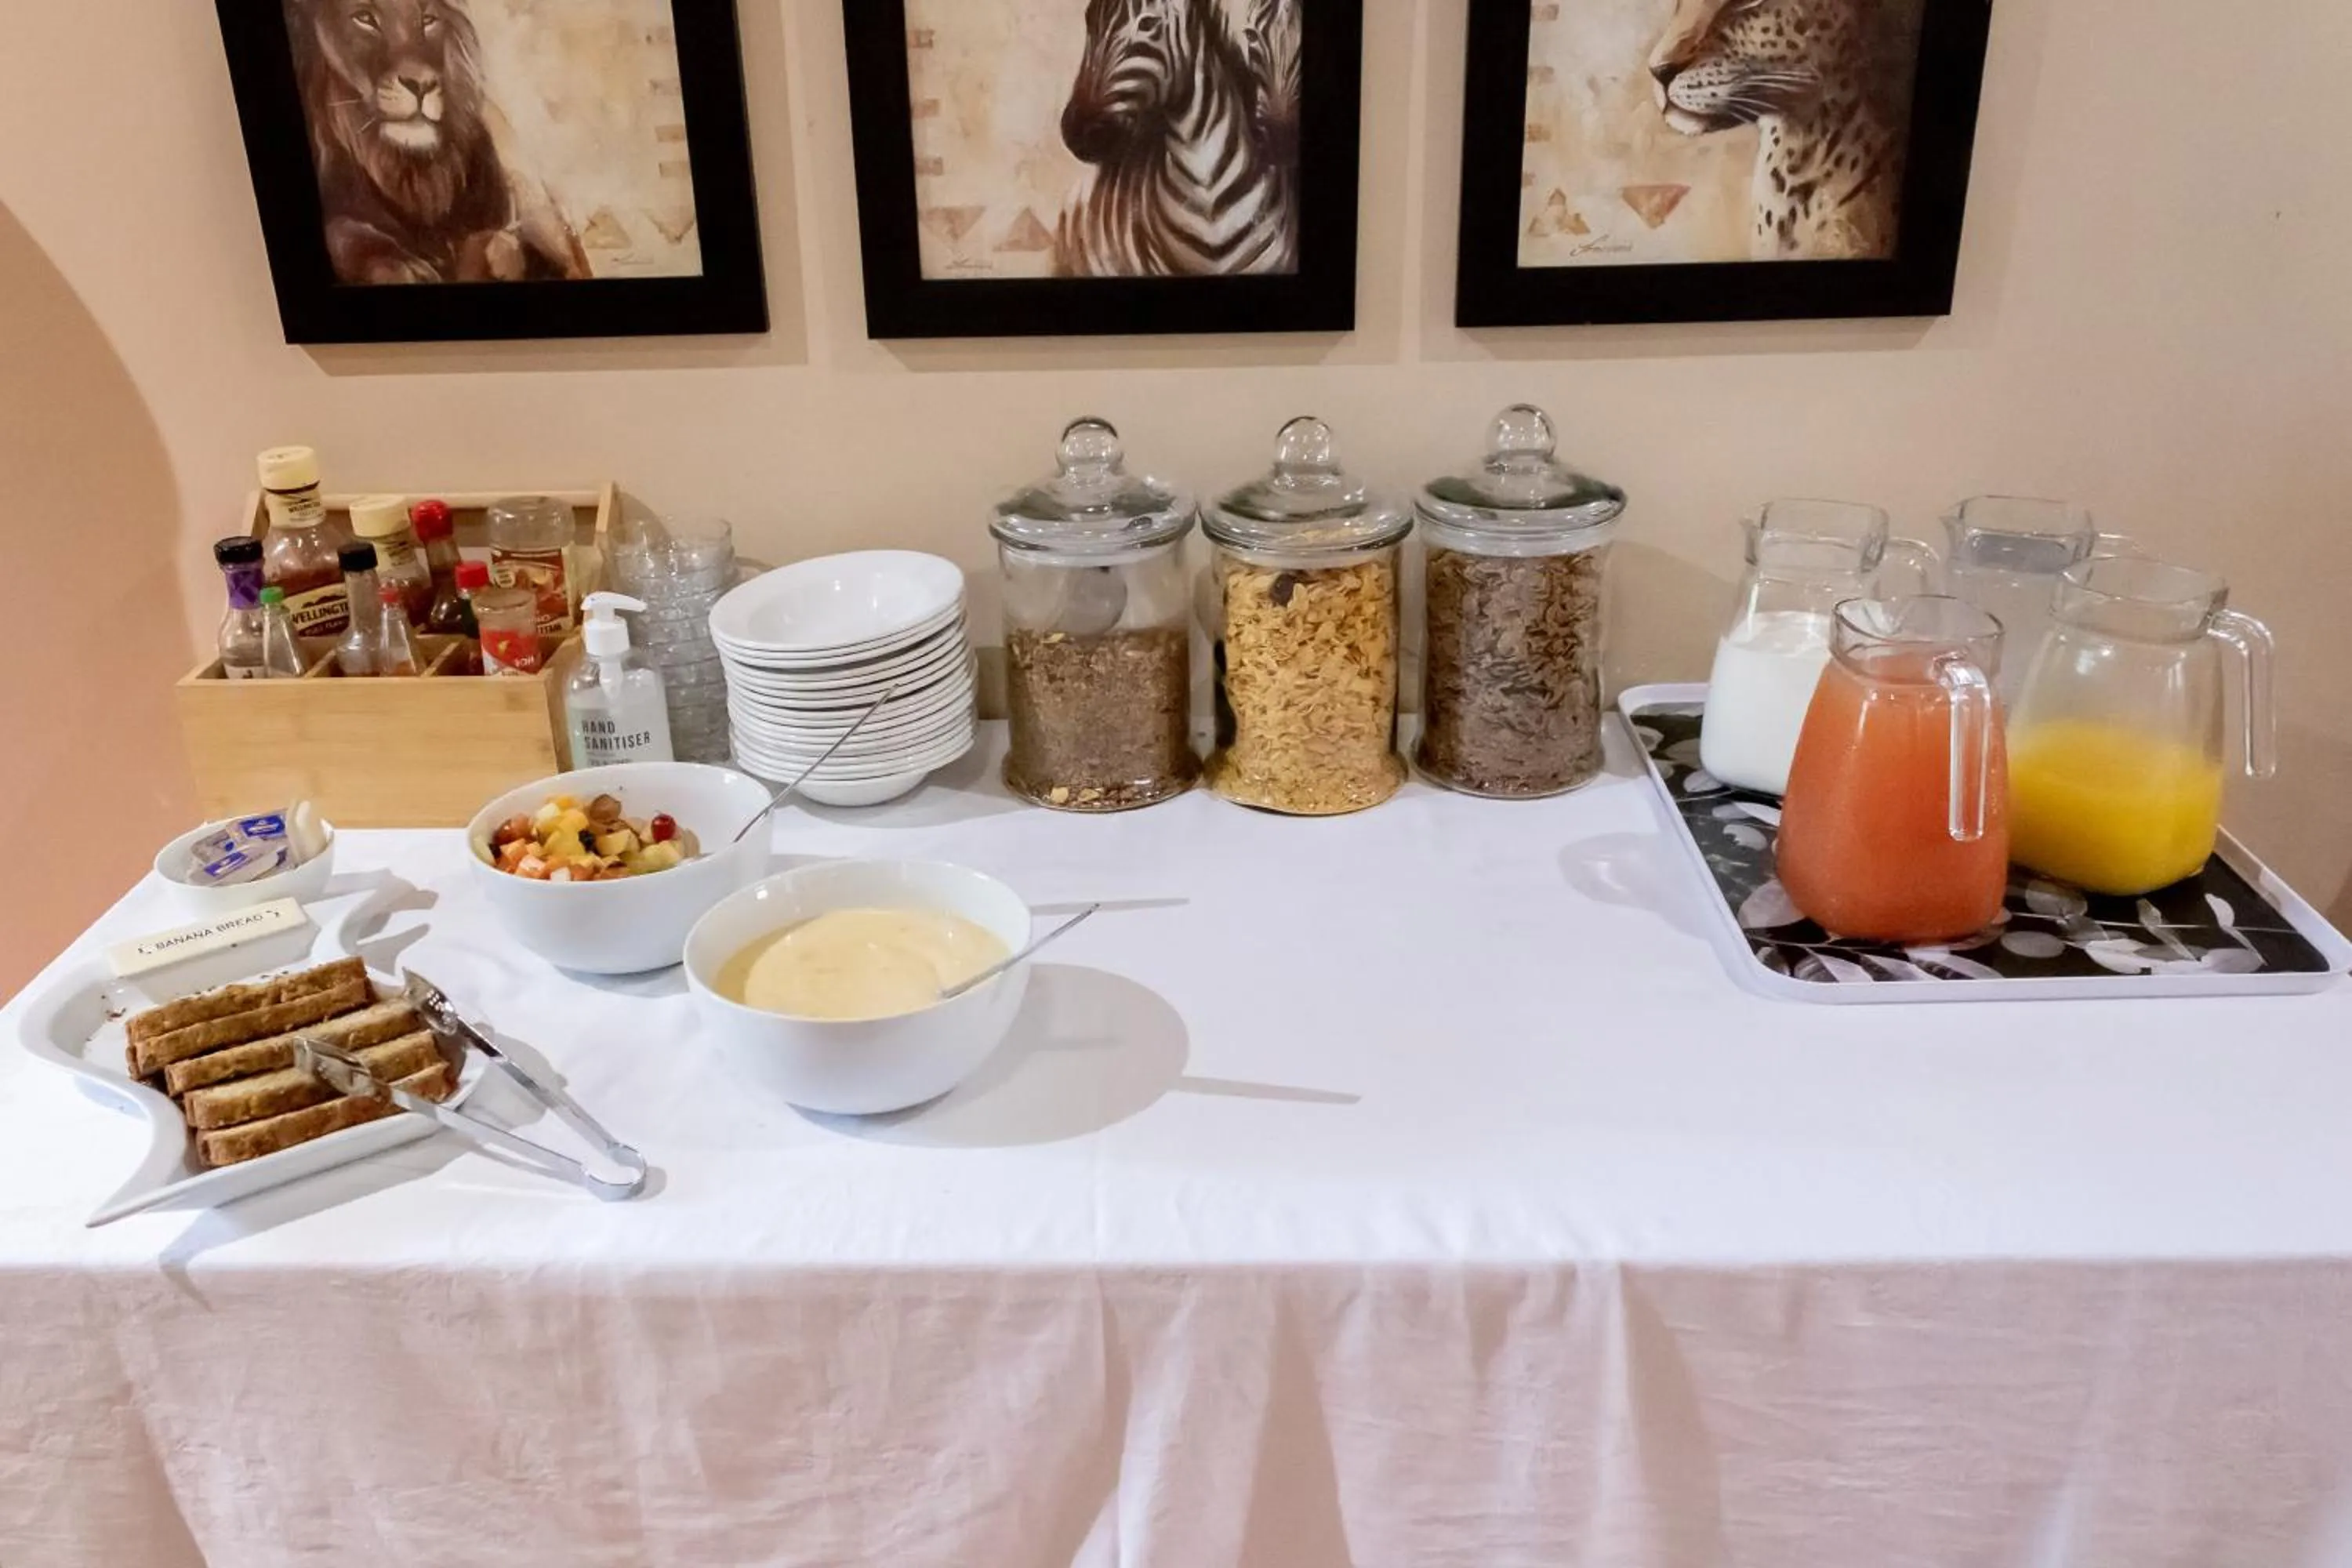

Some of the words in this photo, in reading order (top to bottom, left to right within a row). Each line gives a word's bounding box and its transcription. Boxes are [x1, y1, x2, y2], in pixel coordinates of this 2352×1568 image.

[582, 720, 615, 735] HAND
[584, 730, 651, 750] SANITISER
[156, 929, 214, 949] BANANA
[216, 914, 263, 933] BREAD
